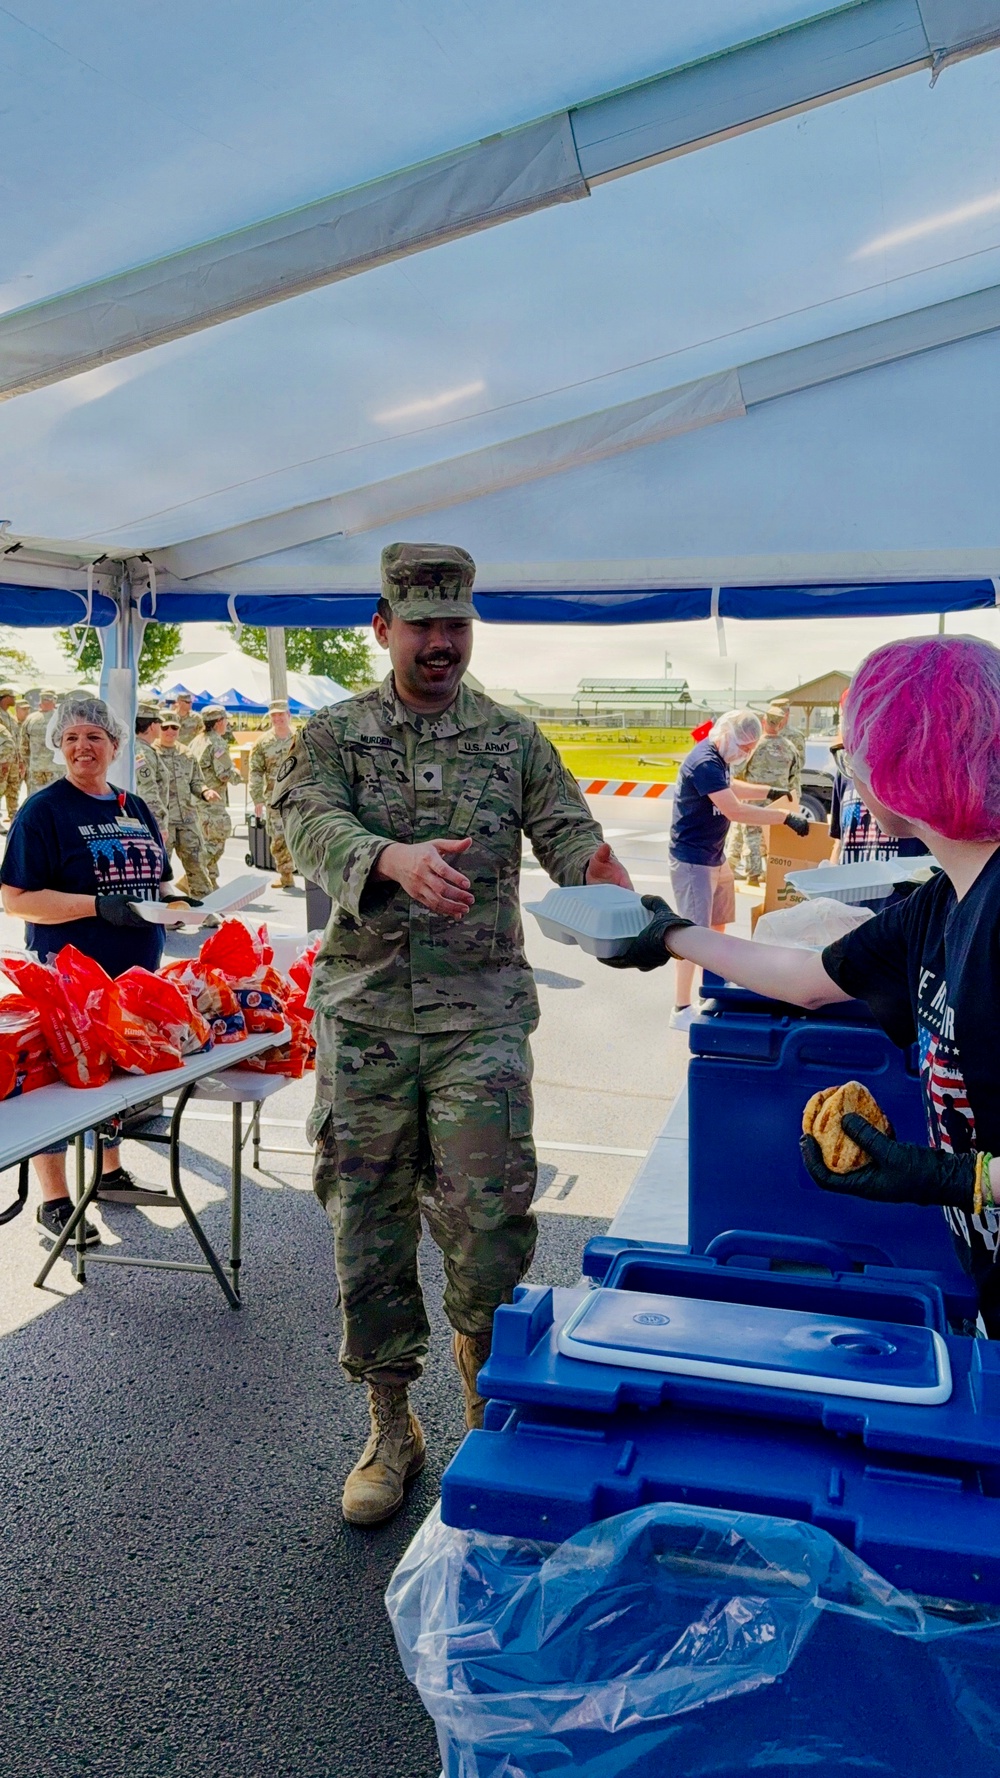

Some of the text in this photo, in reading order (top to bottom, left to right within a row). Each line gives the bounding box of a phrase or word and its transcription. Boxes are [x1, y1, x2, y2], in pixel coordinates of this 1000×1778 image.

[360, 735, 392, 746] MURDEN
[464, 742, 511, 752] U.S. ARMY
[78, 824, 98, 836] WE
[770, 857, 792, 867] 26010
